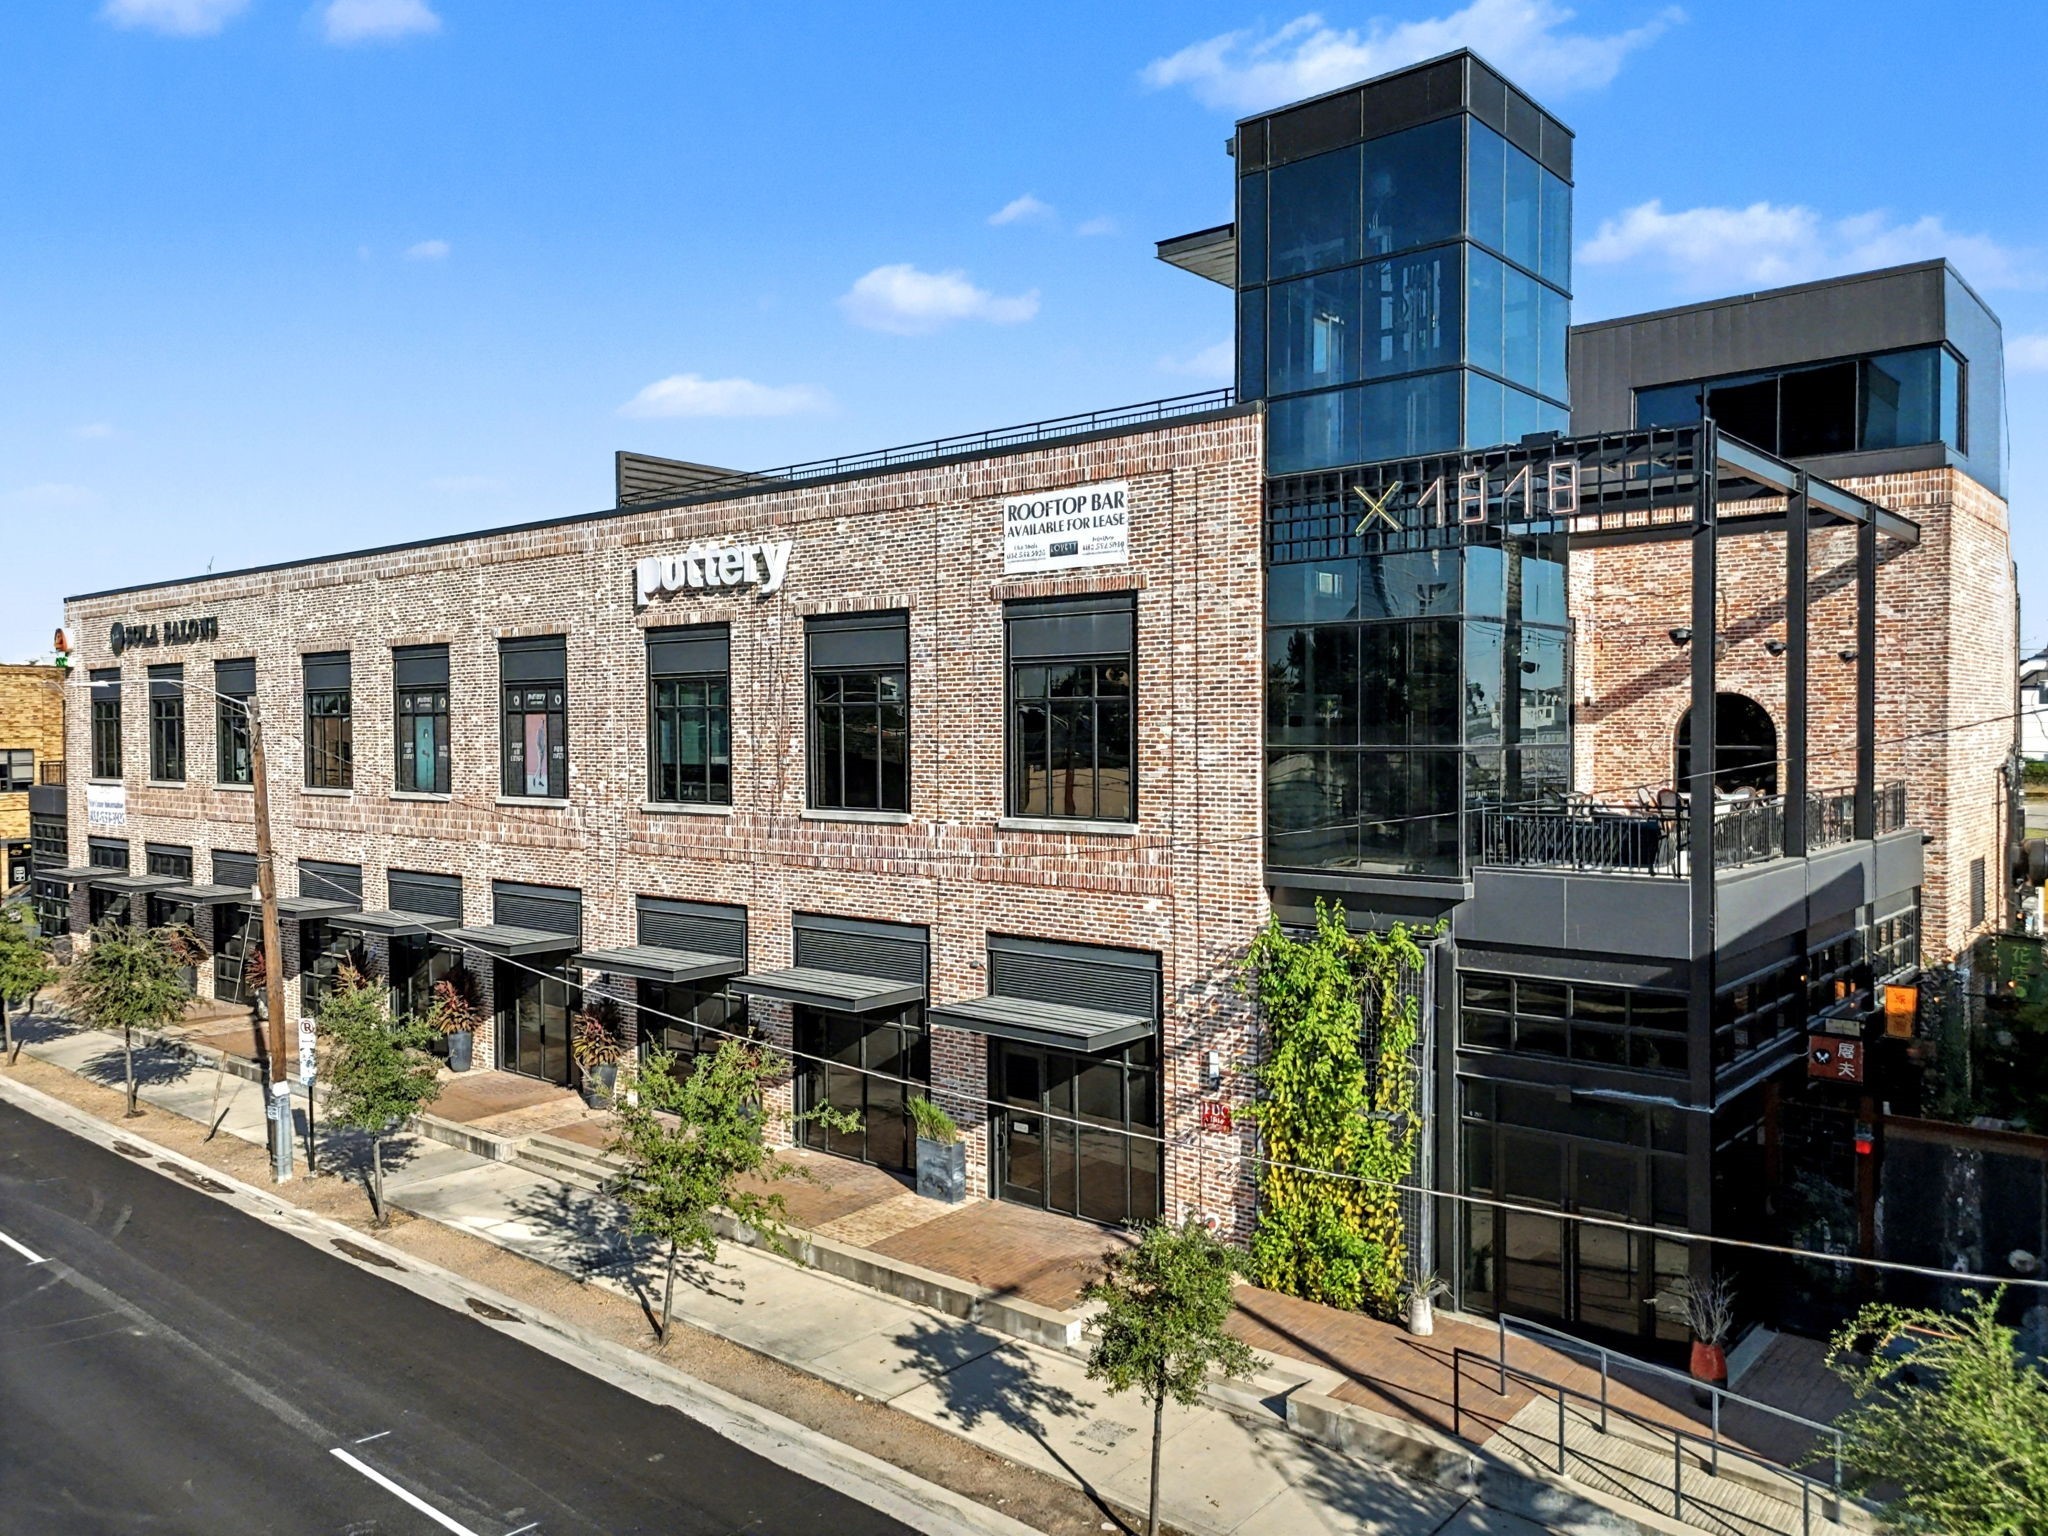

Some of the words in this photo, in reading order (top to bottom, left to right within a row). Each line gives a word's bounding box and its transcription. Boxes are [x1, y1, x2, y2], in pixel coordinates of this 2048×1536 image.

[1007, 495, 1087, 522] ROOFTOP
[1090, 490, 1125, 512] BAR
[1417, 460, 1581, 528] 1818
[1007, 520, 1065, 538] AVAILABLE
[1067, 516, 1091, 532] FOR
[1093, 512, 1125, 528] LEASE
[636, 540, 794, 606] puttery
